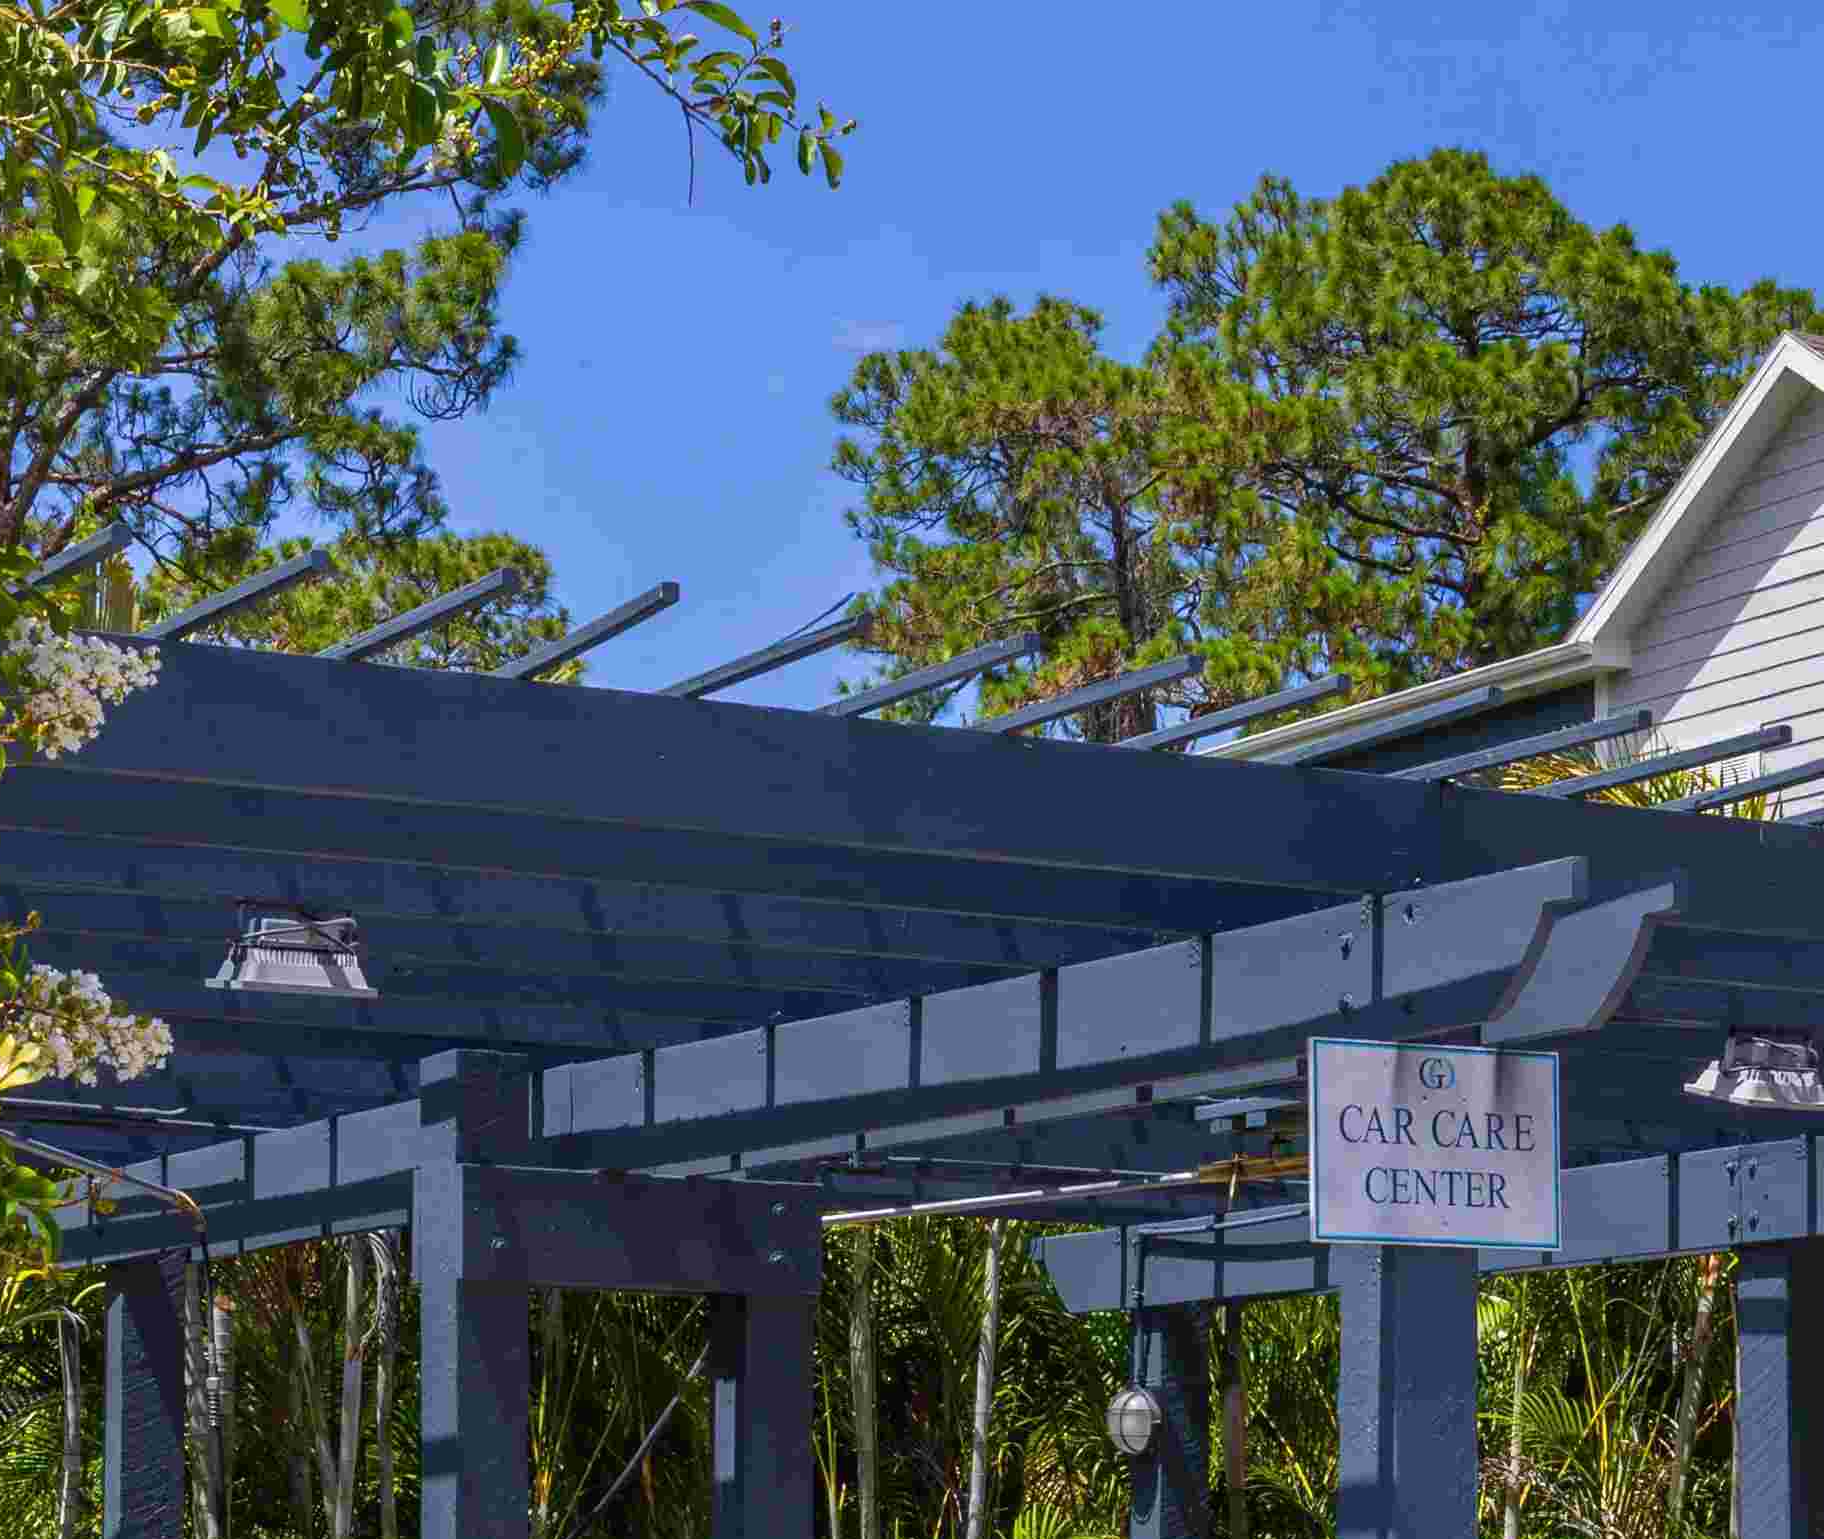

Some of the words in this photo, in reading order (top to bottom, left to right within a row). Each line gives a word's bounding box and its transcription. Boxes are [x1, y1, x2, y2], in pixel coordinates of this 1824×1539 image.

[1339, 1104, 1417, 1146] CAR
[1432, 1110, 1536, 1152] CARE
[1364, 1167, 1511, 1209] CENTER
